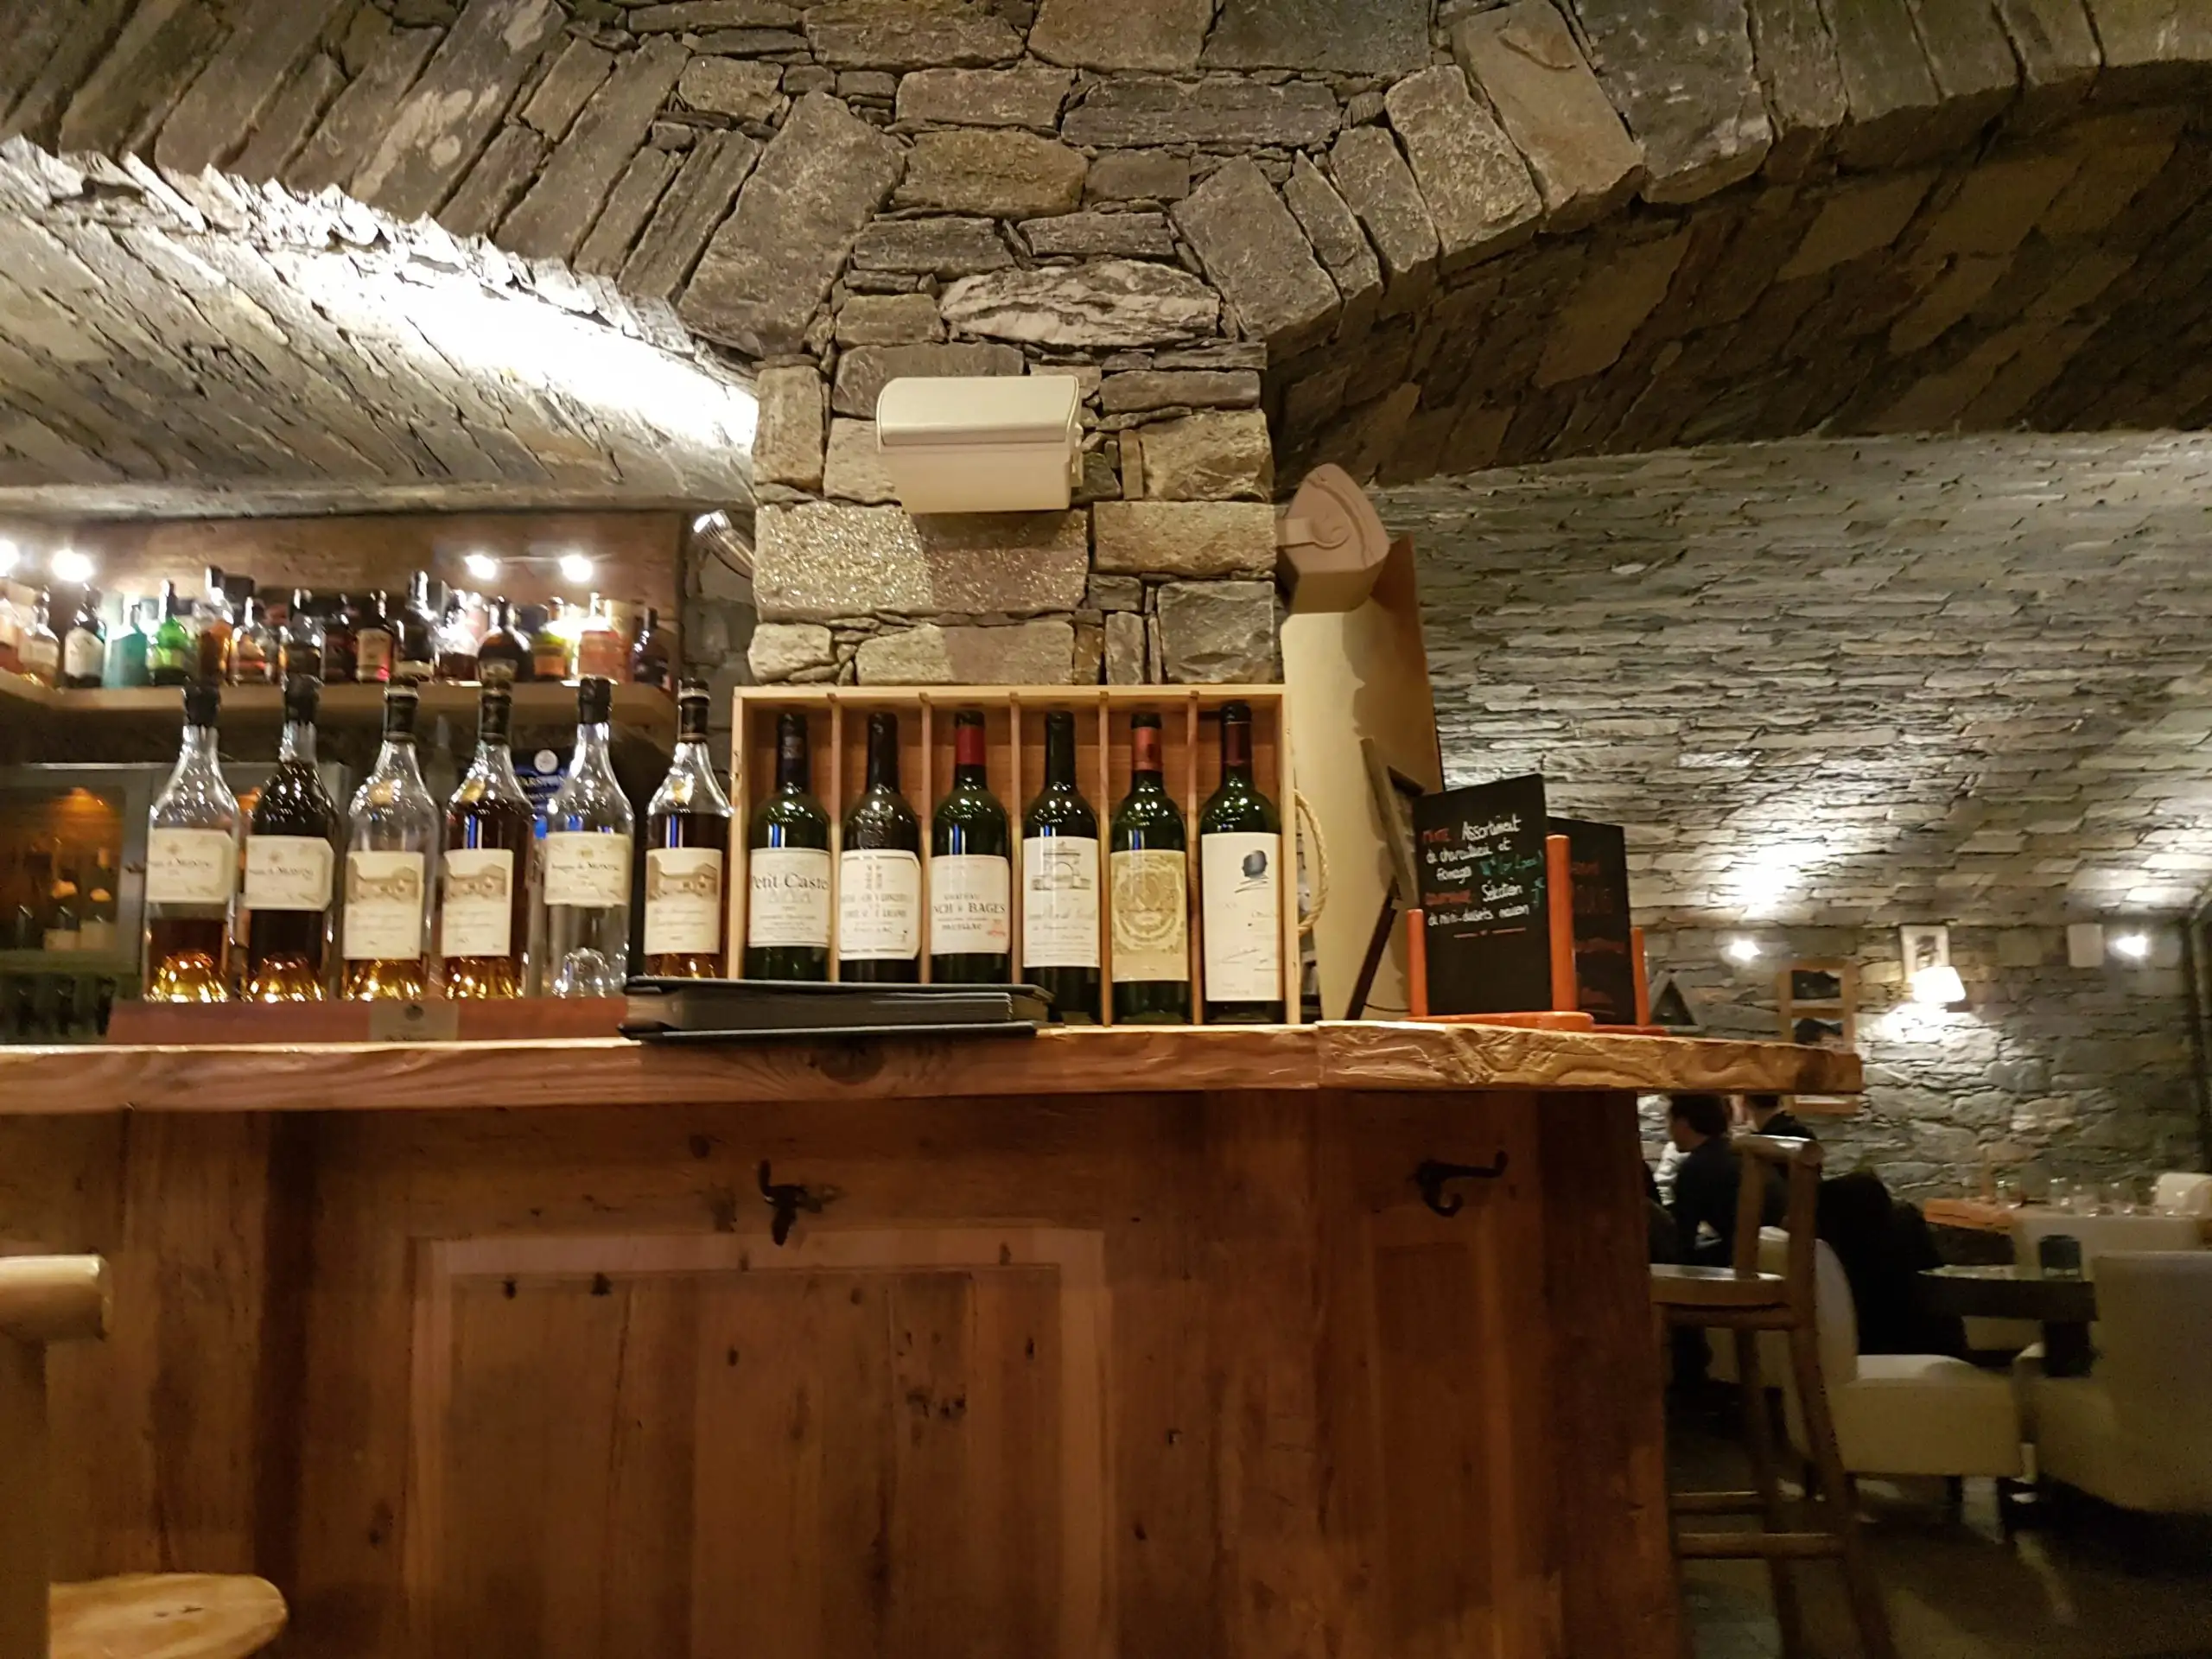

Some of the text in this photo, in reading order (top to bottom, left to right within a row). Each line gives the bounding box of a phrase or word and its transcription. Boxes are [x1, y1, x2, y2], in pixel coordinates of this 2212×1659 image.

[1462, 814, 1522, 842] Assortiment
[1497, 836, 1512, 851] et
[967, 902, 1006, 914] BAGES
